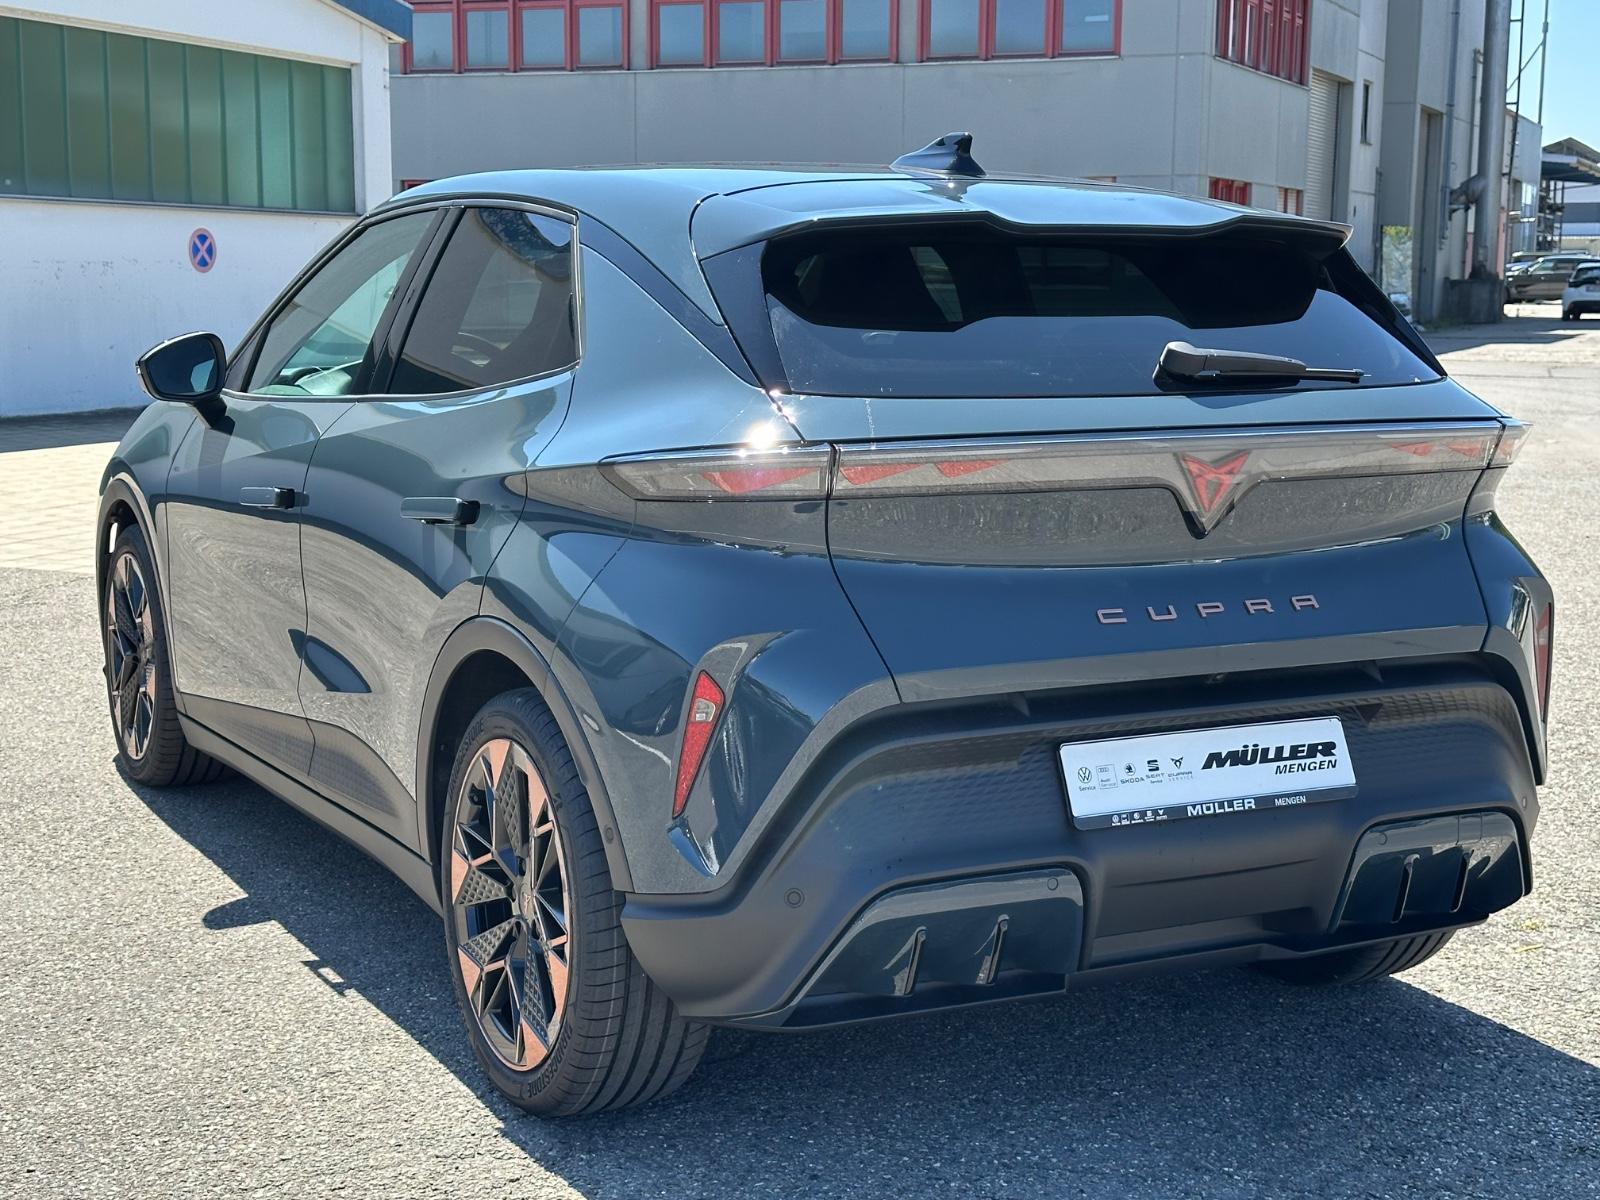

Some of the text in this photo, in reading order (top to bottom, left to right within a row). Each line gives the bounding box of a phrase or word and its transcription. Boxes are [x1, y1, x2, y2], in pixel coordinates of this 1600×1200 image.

[1096, 594, 1320, 624] CUPRA
[1201, 741, 1337, 770] MÜLLER
[1274, 759, 1337, 775] MENGEN
[1079, 784, 1096, 792] Service
[1187, 798, 1256, 817] MÜLLER
[1274, 795, 1306, 807] MENGEN
